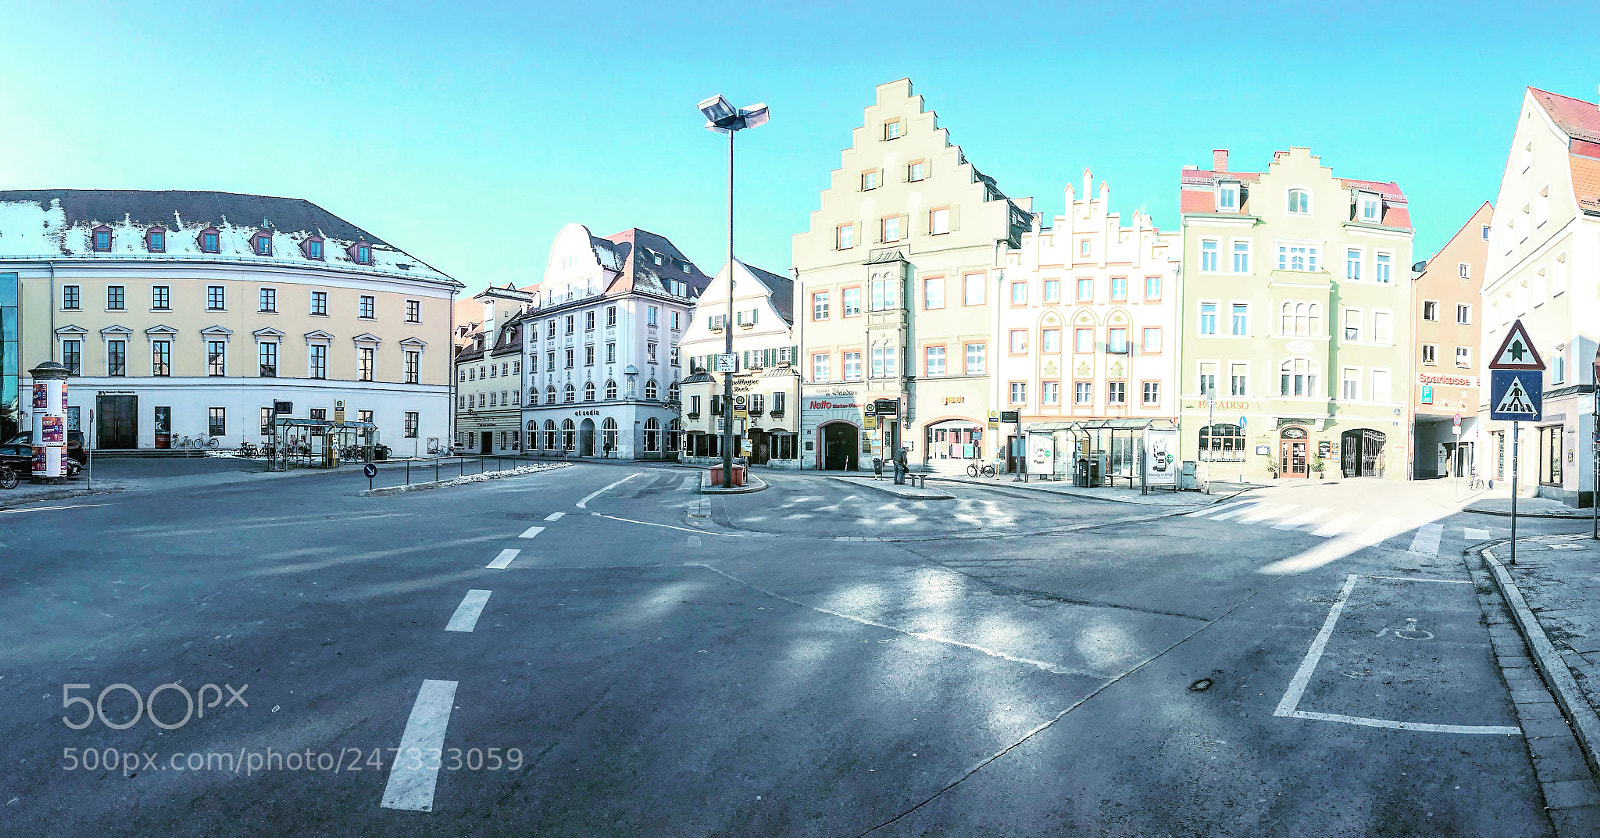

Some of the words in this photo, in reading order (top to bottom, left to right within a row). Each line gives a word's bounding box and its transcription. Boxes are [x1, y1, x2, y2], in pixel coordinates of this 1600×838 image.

[1419, 374, 1471, 386] Sparkasse
[810, 400, 832, 410] Netto
[1198, 400, 1249, 410] PARADISO
